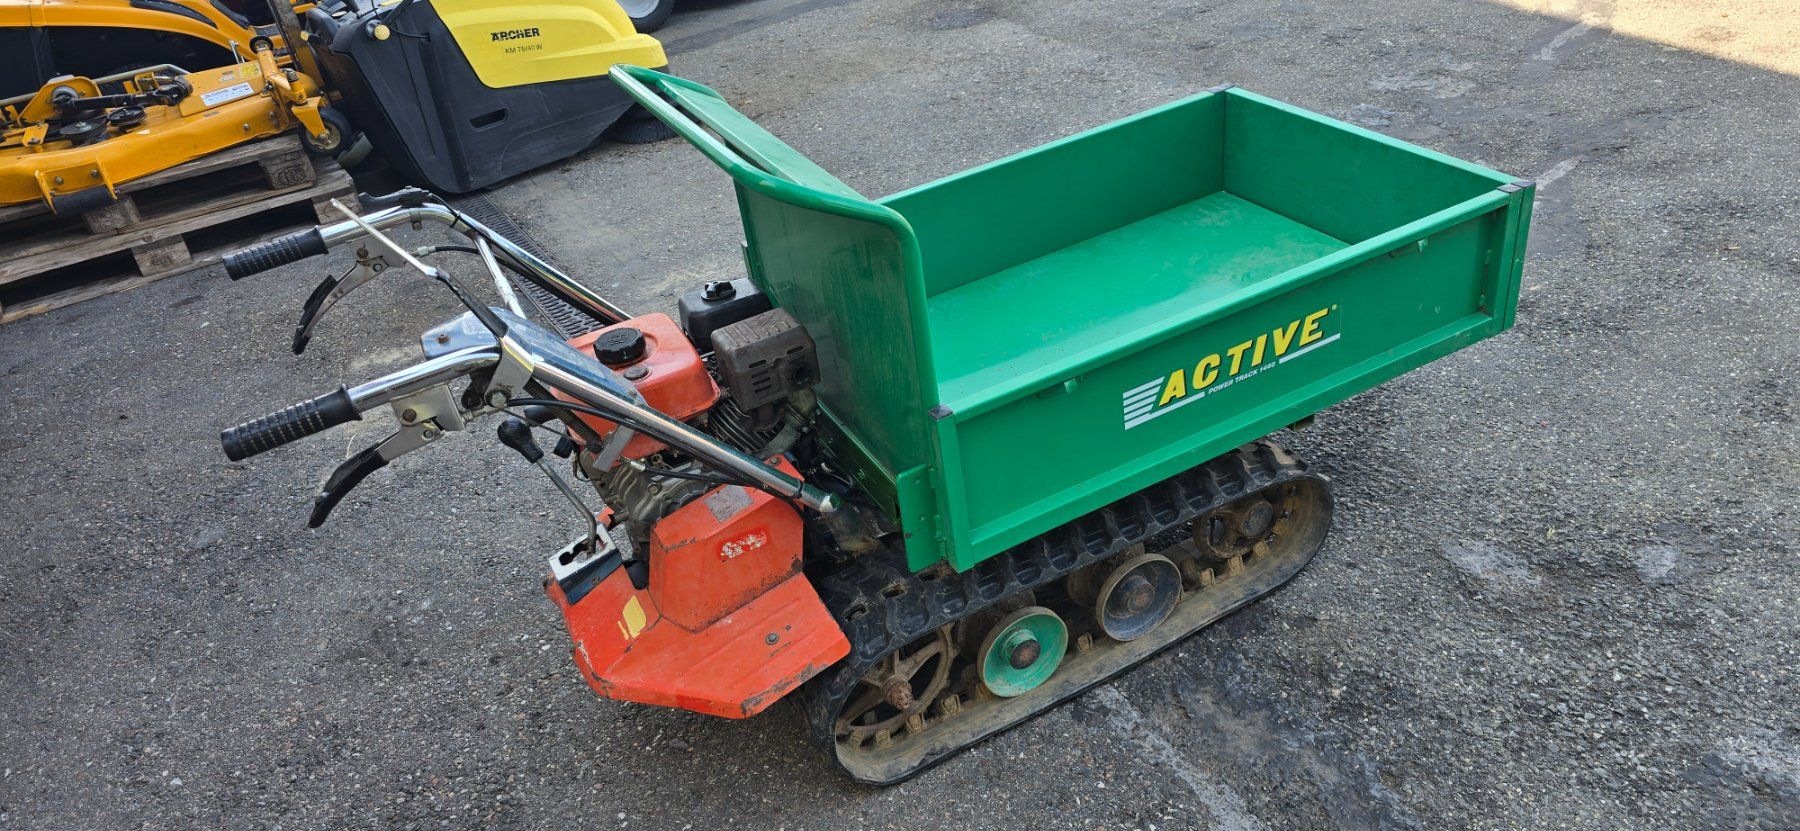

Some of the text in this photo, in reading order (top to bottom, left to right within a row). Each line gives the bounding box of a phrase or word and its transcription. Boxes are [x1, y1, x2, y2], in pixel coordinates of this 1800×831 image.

[1158, 308, 1329, 407] ACTIVE
[1208, 379, 1234, 394] POWER
[1235, 369, 1258, 383] TRACK
